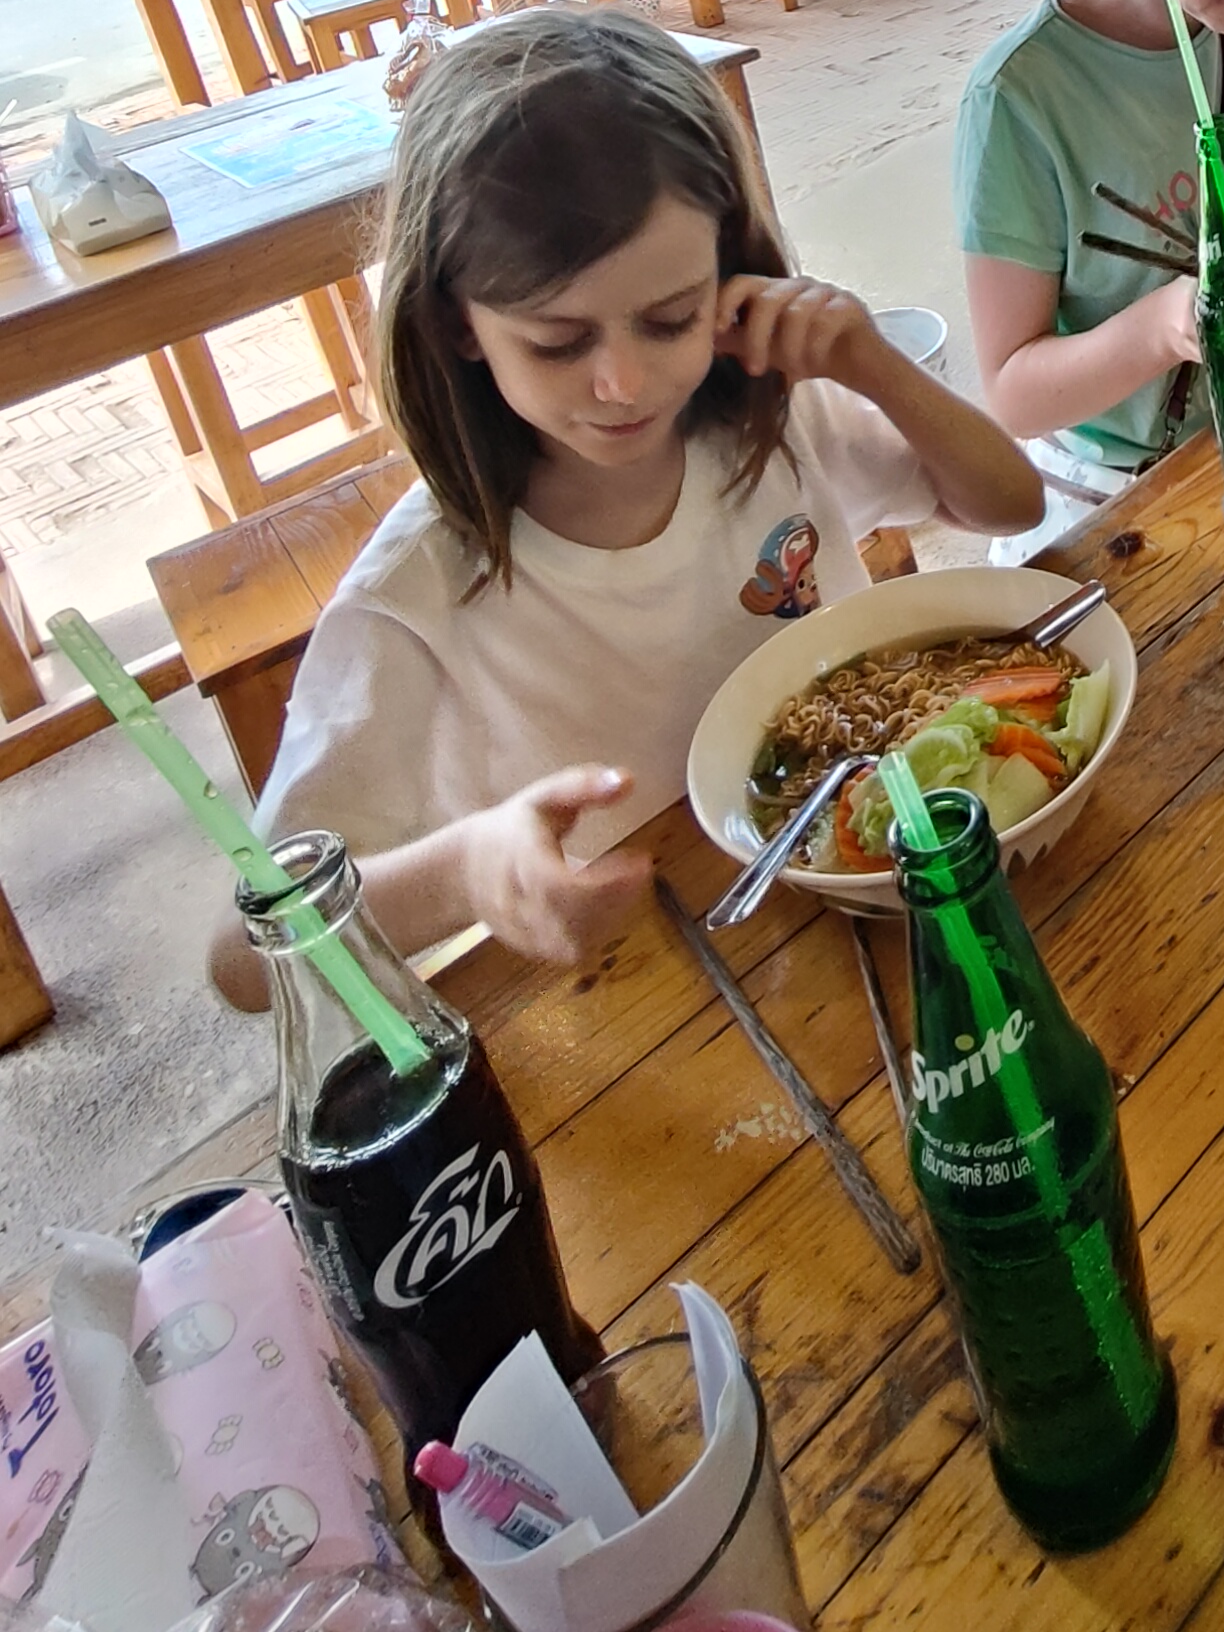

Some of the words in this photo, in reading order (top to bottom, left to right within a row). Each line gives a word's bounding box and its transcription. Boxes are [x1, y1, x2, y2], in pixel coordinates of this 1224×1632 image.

[911, 1009, 1027, 1113] Sprite
[985, 1161, 1010, 1186] 280
[1011, 1156, 1036, 1180] มล.
